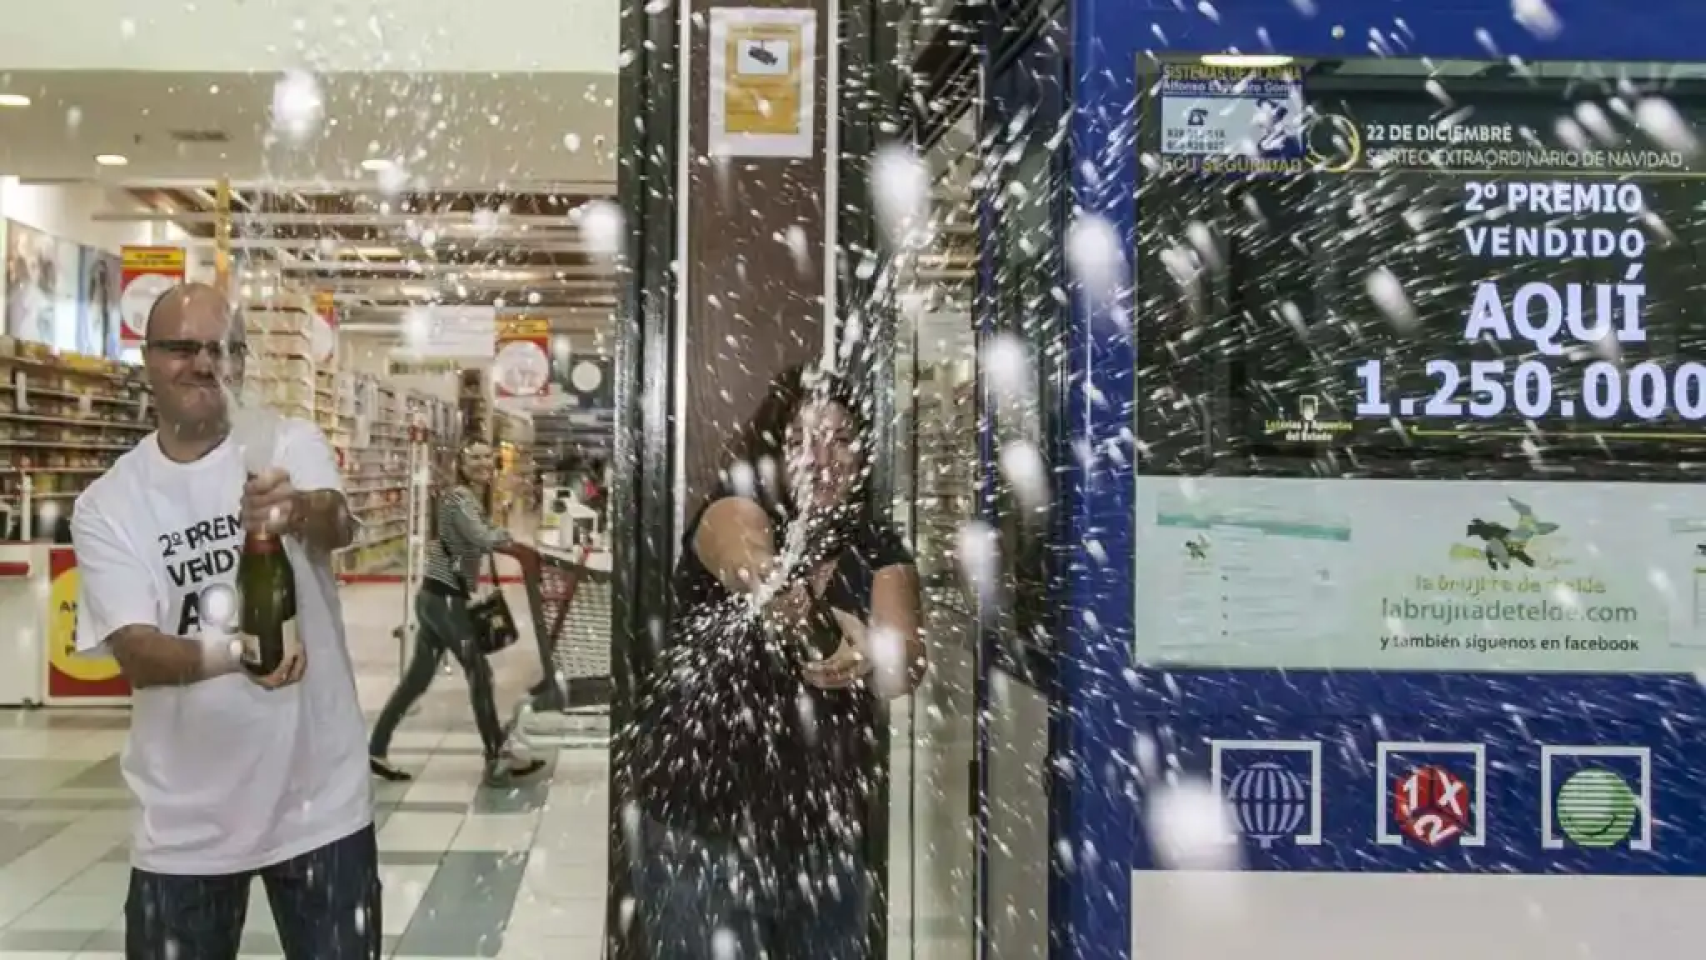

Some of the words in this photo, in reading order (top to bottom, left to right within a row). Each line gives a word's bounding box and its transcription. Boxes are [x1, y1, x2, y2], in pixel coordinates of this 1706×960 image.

[1366, 124, 1384, 141] 22
[1389, 124, 1413, 141] DE
[1417, 124, 1512, 142] DICIEMBRE
[1366, 149, 1431, 166] SRTEO
[1582, 152, 1605, 167] DE
[1608, 152, 1682, 168] NAVIDAD
[1465, 182, 1497, 211] 2º
[1507, 182, 1642, 213] PREMIO
[1465, 226, 1645, 257] VENDIDO
[1465, 263, 1646, 355] AQUÍ
[1356, 360, 1706, 418] 1.250.000
[159, 532, 183, 557] 2º
[185, 514, 243, 549] PREM
[167, 550, 236, 587] VEND
[1381, 637, 1390, 650] y
[1393, 633, 1460, 648] también
[1541, 637, 1560, 650] en
[1565, 635, 1639, 651] facebook
